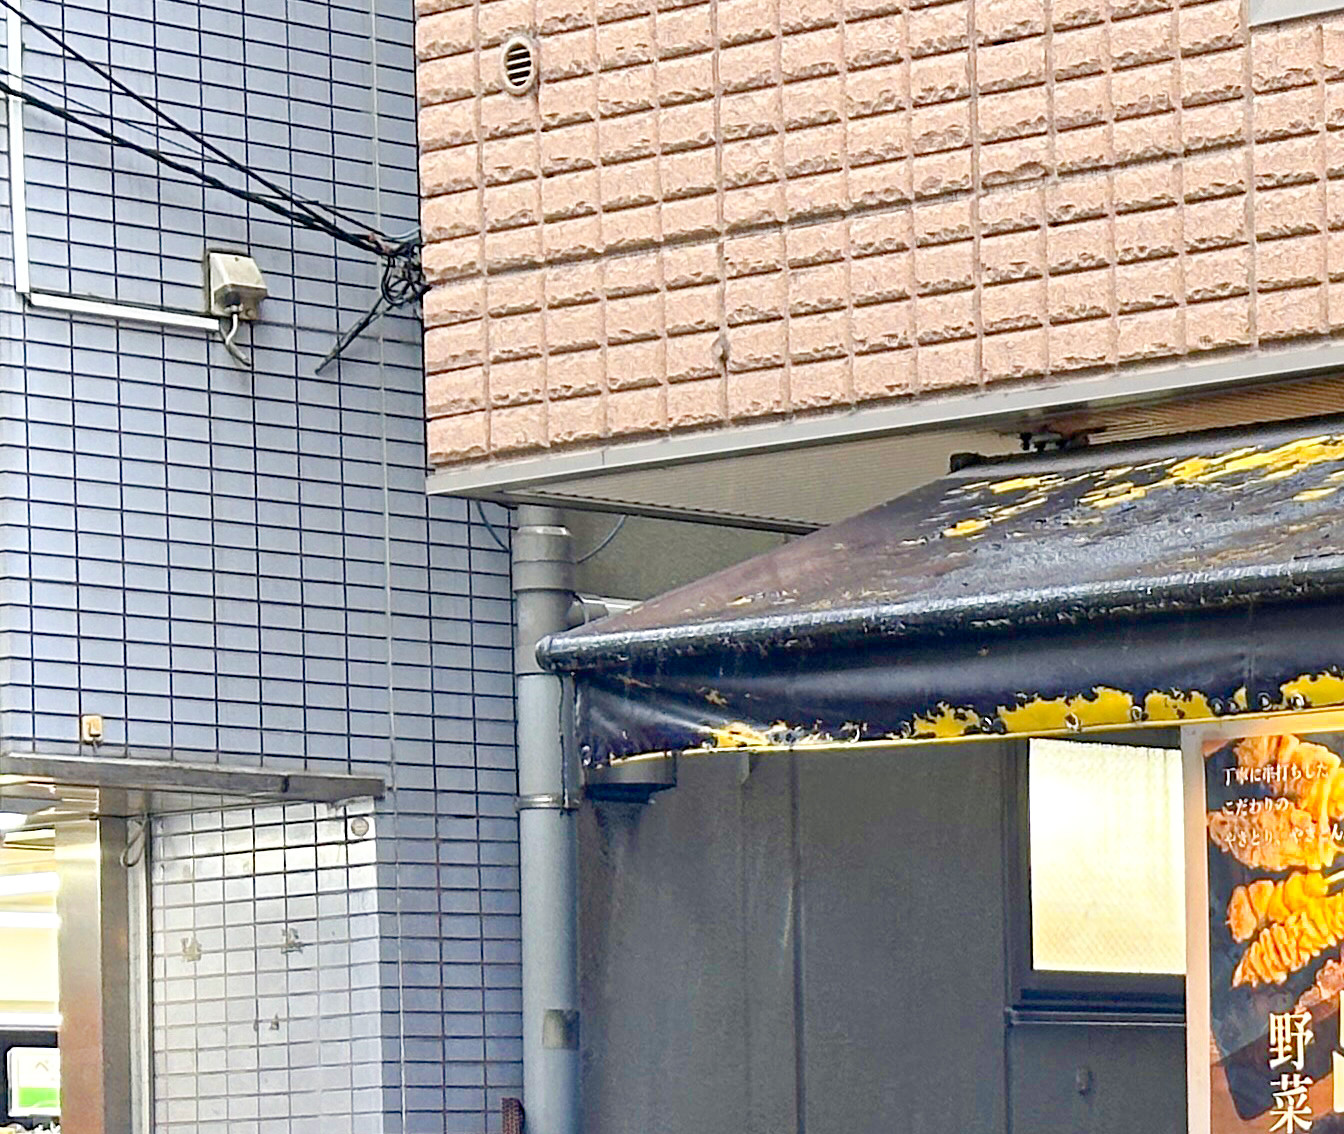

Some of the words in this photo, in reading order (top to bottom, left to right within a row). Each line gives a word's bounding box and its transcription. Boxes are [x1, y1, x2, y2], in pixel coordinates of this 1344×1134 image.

[1221, 796, 1290, 816] こだわりの
